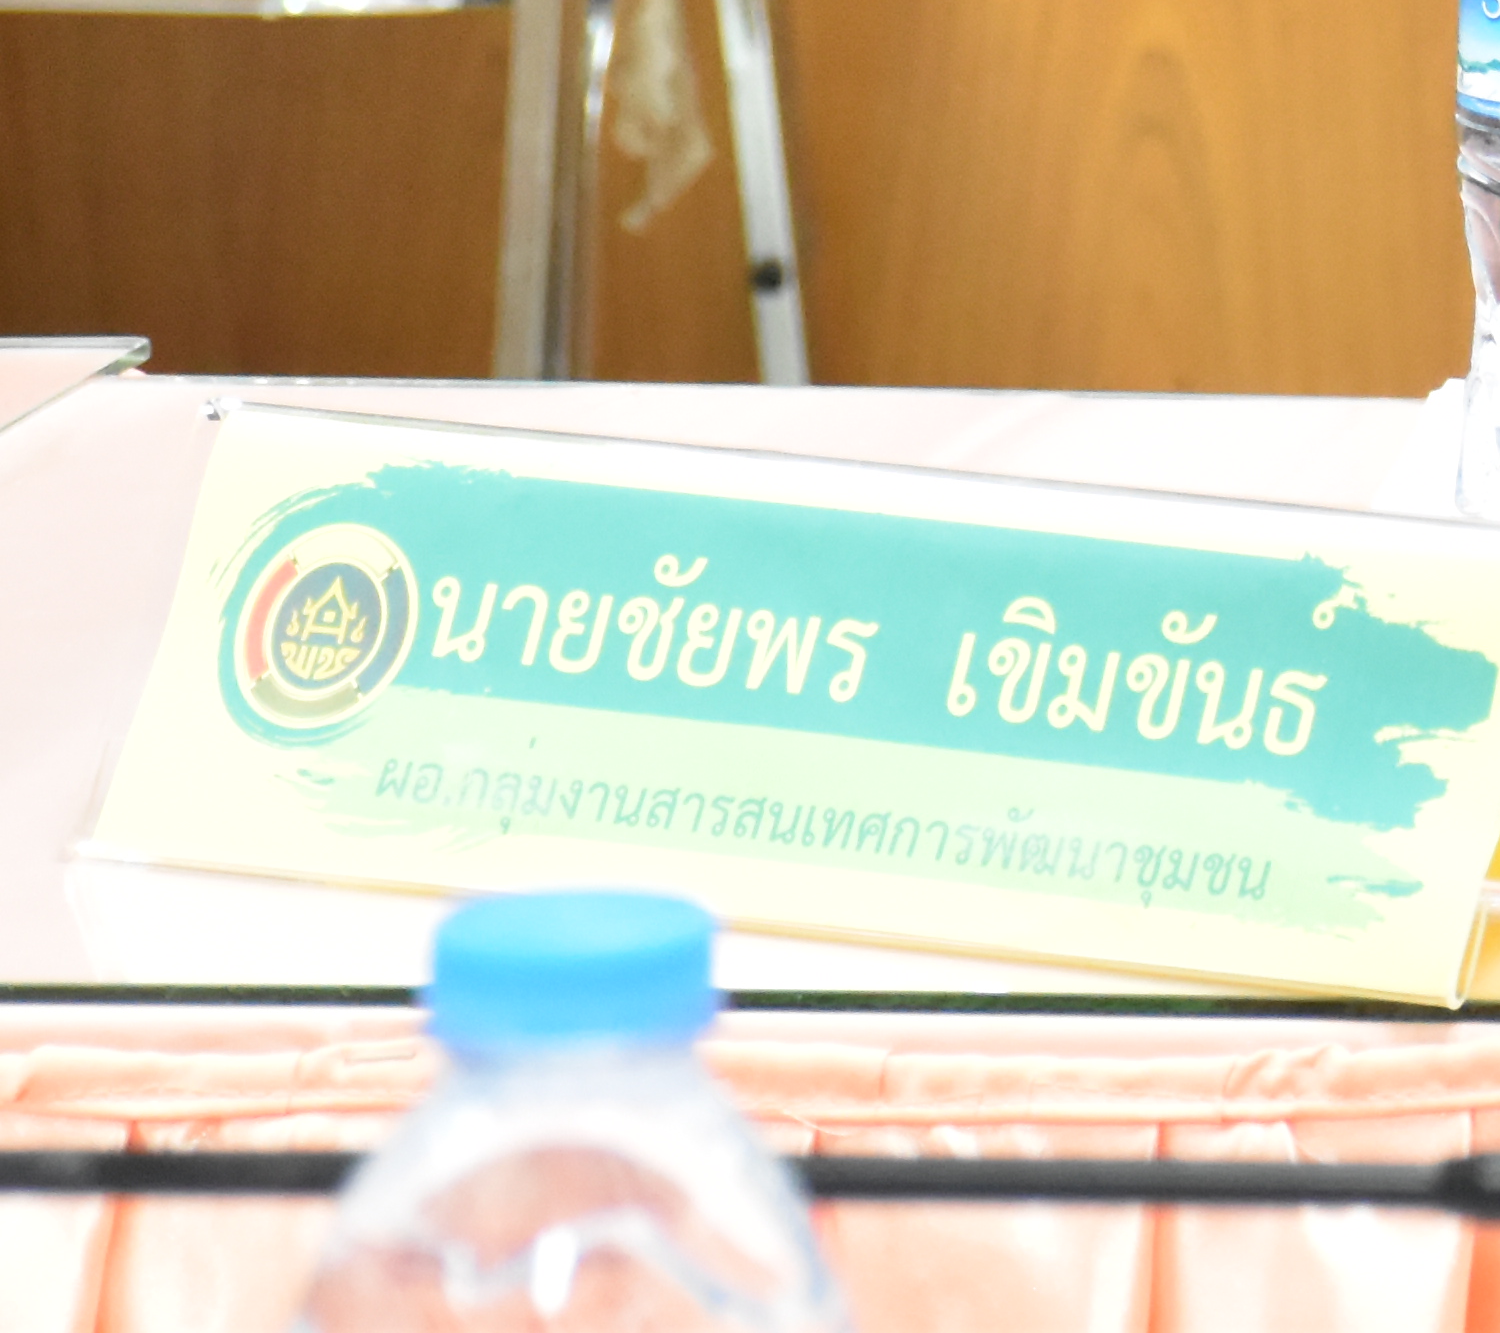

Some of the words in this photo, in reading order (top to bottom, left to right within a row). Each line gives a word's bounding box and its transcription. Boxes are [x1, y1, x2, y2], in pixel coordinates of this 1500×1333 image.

[431, 554, 879, 703] นายชัยพร
[946, 585, 1357, 756] เขิมขันธ์
[374, 737, 1273, 908] ผอ.กลุ่มงานสารสนเทศการพัฒนาชุมชน
